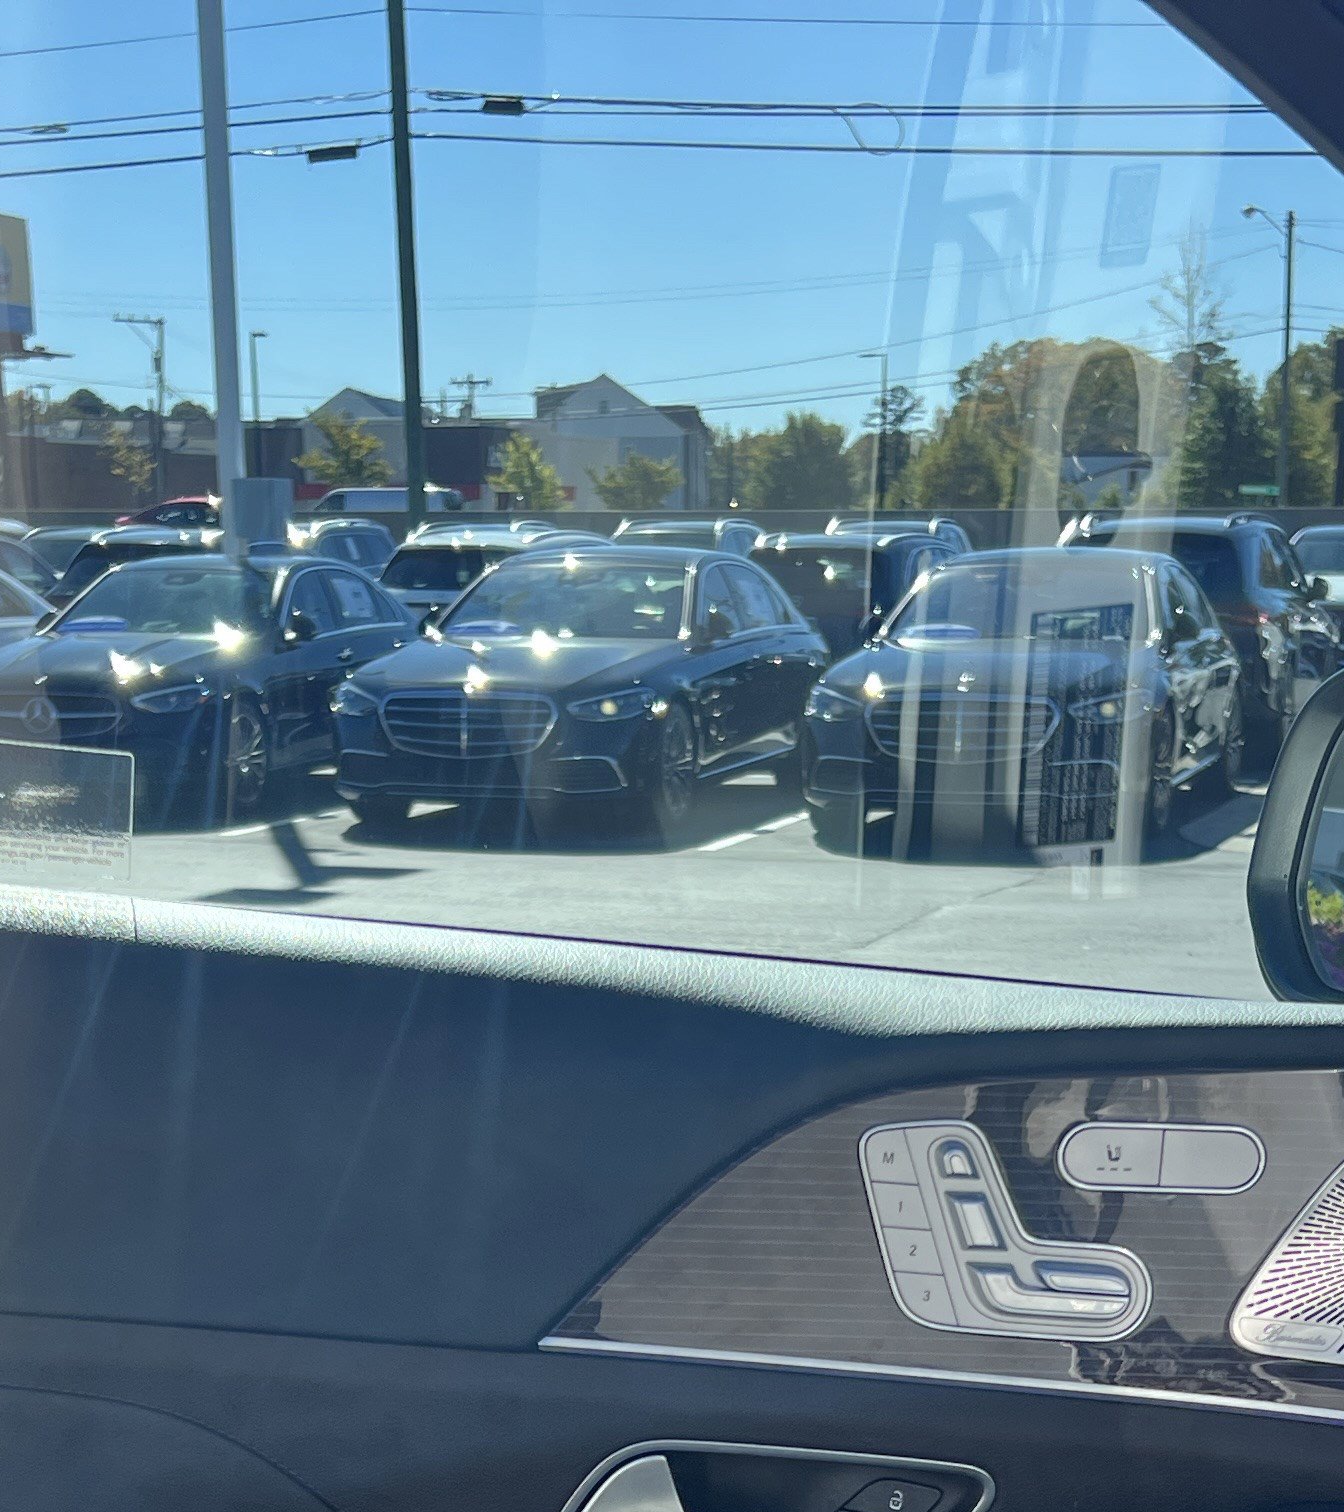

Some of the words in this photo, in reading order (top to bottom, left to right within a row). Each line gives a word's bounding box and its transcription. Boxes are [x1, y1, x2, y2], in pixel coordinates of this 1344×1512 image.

[882, 1152, 895, 1165] M
[898, 1200, 903, 1213] 1
[909, 1244, 918, 1257] 2
[922, 1290, 931, 1302] 3
